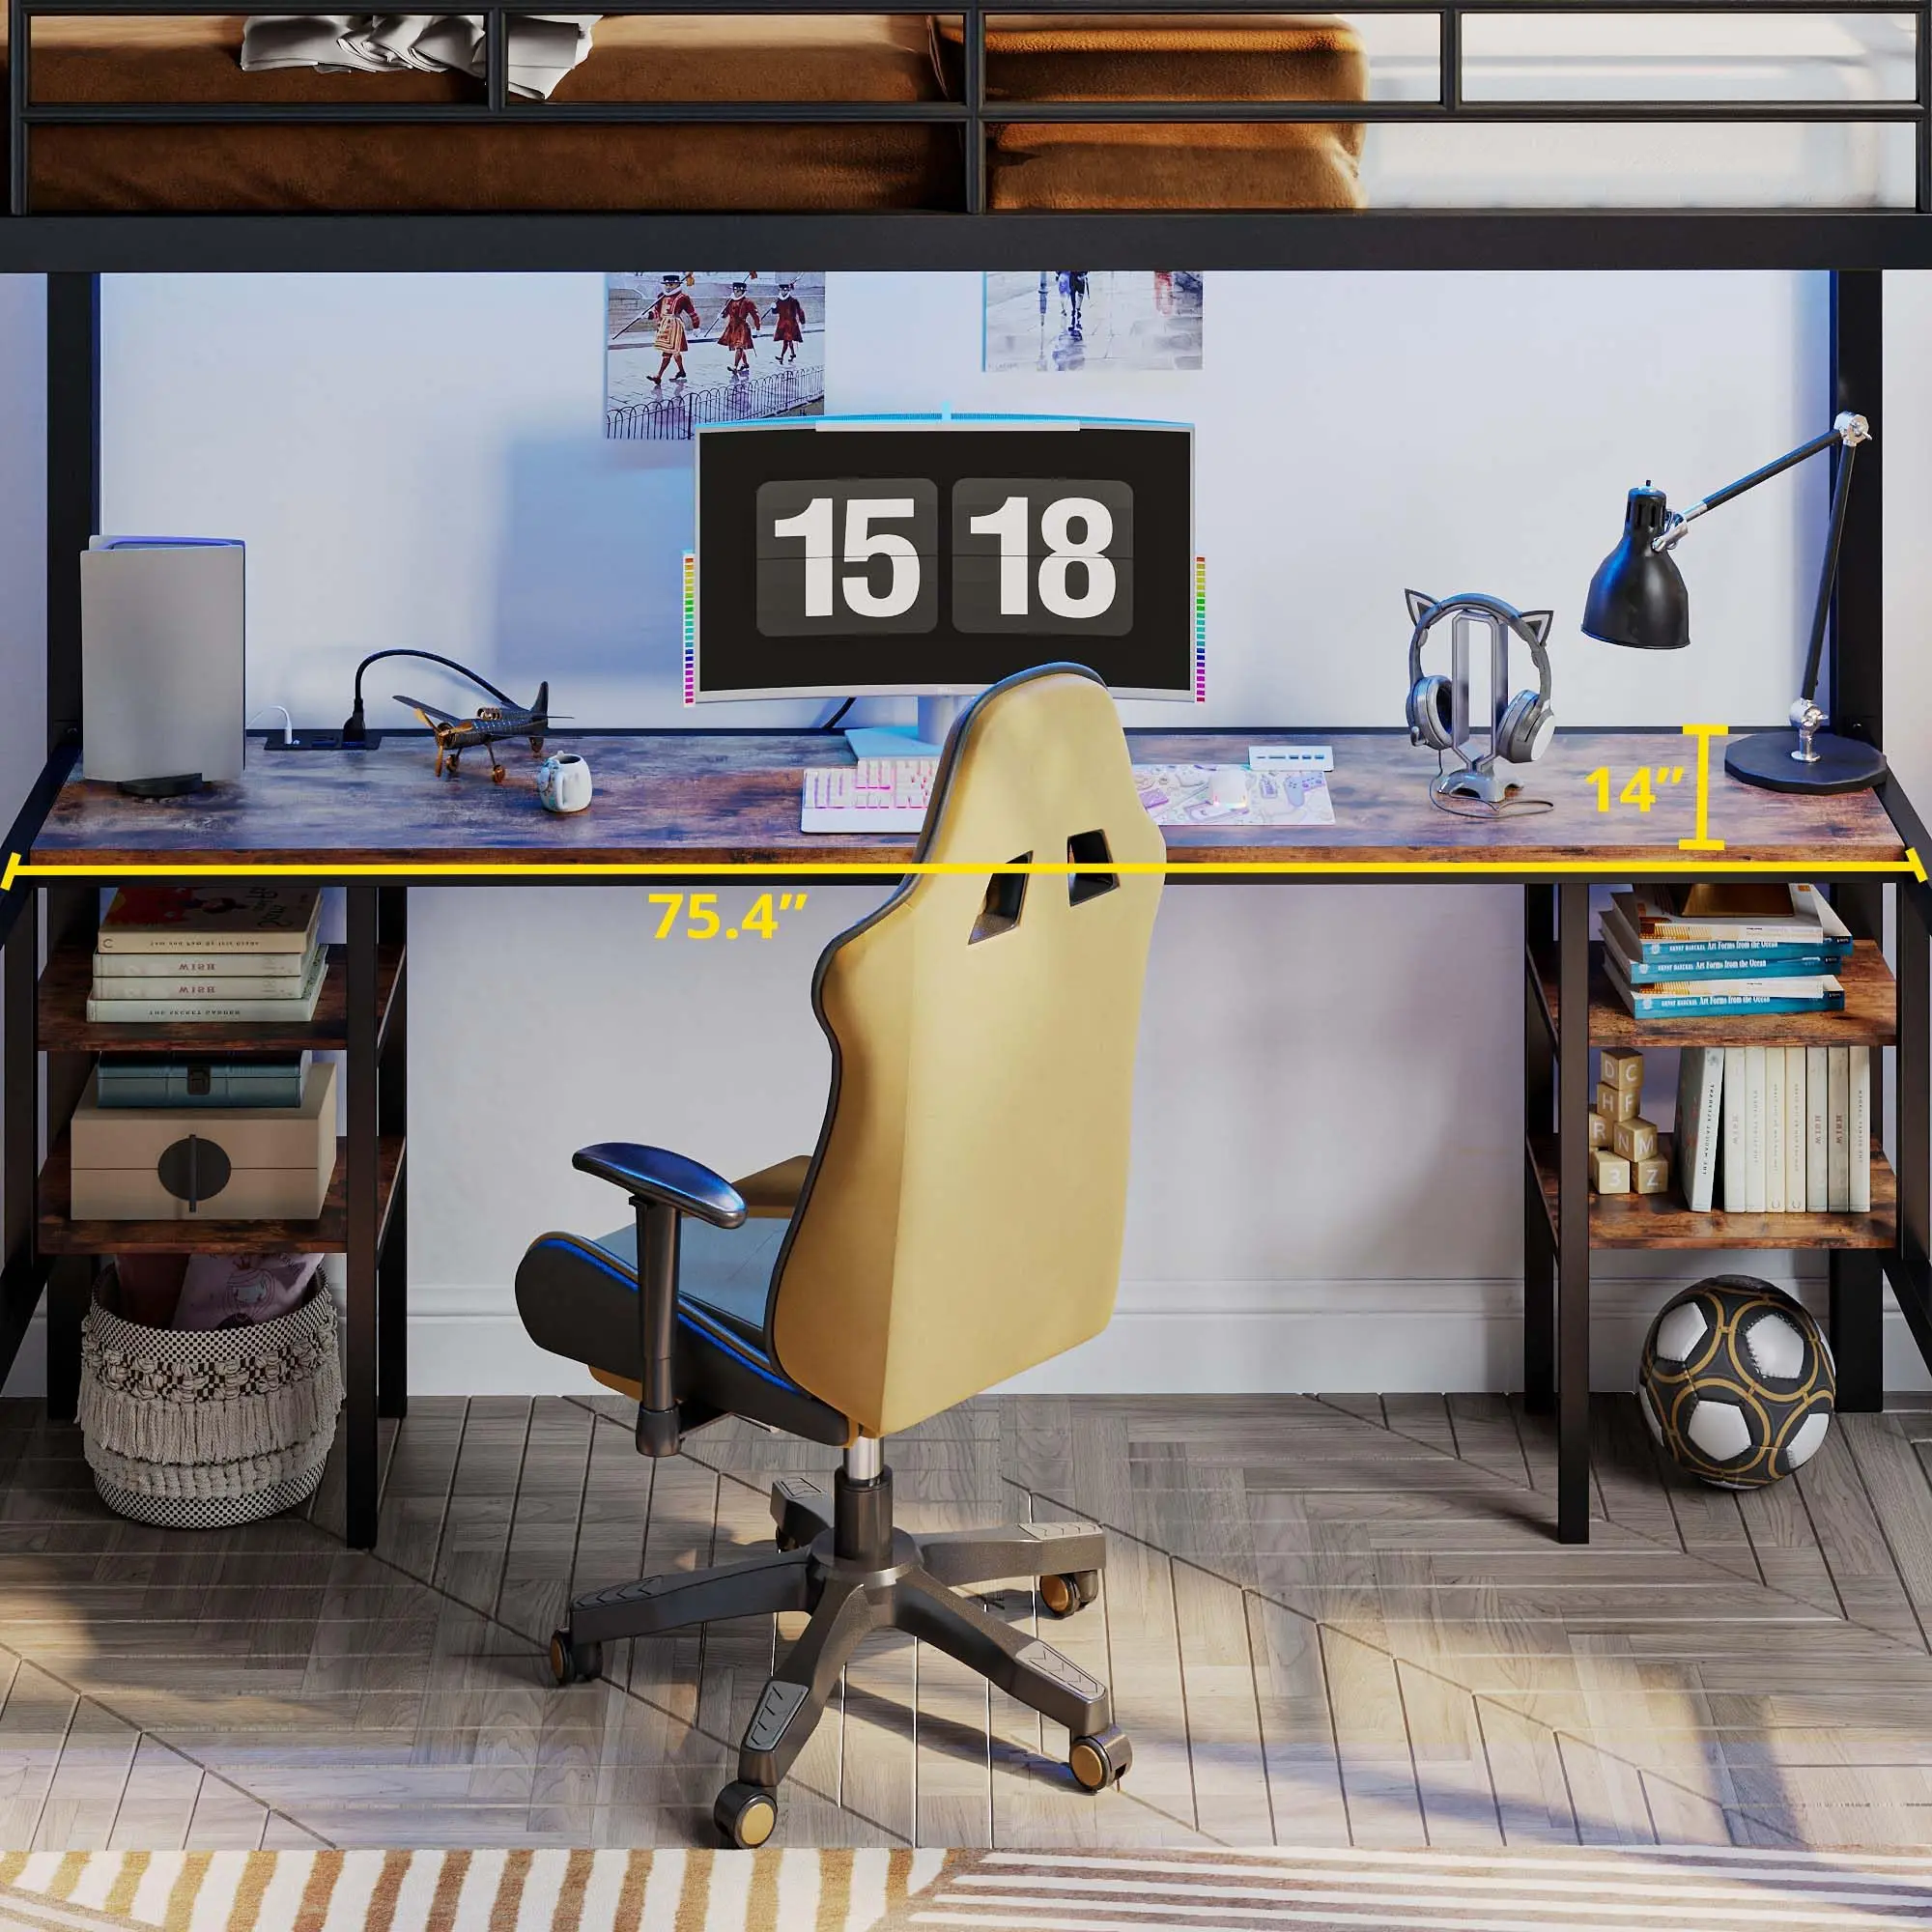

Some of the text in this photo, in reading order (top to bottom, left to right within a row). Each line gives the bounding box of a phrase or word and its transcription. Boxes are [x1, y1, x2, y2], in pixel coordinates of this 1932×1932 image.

[774, 496, 1117, 618] 15 18
[1707, 942, 1717, 951] Art
[1718, 941, 1734, 950] Forms
[1736, 941, 1750, 950] from
[1695, 961, 1705, 970] Art
[1724, 960, 1739, 969] from
[1699, 997, 1709, 1006] Art
[1728, 996, 1743, 1005] from
[1605, 1060, 1614, 1078] D
[1626, 1065, 1637, 1082] C
[1603, 1093, 1613, 1111] H
[1625, 1094, 1635, 1113] F
[1594, 1122, 1605, 1140] R
[1618, 1133, 1631, 1152] N
[1638, 1135, 1654, 1155] M
[1608, 1167, 1621, 1187] 3
[1646, 1169, 1659, 1186] Z
